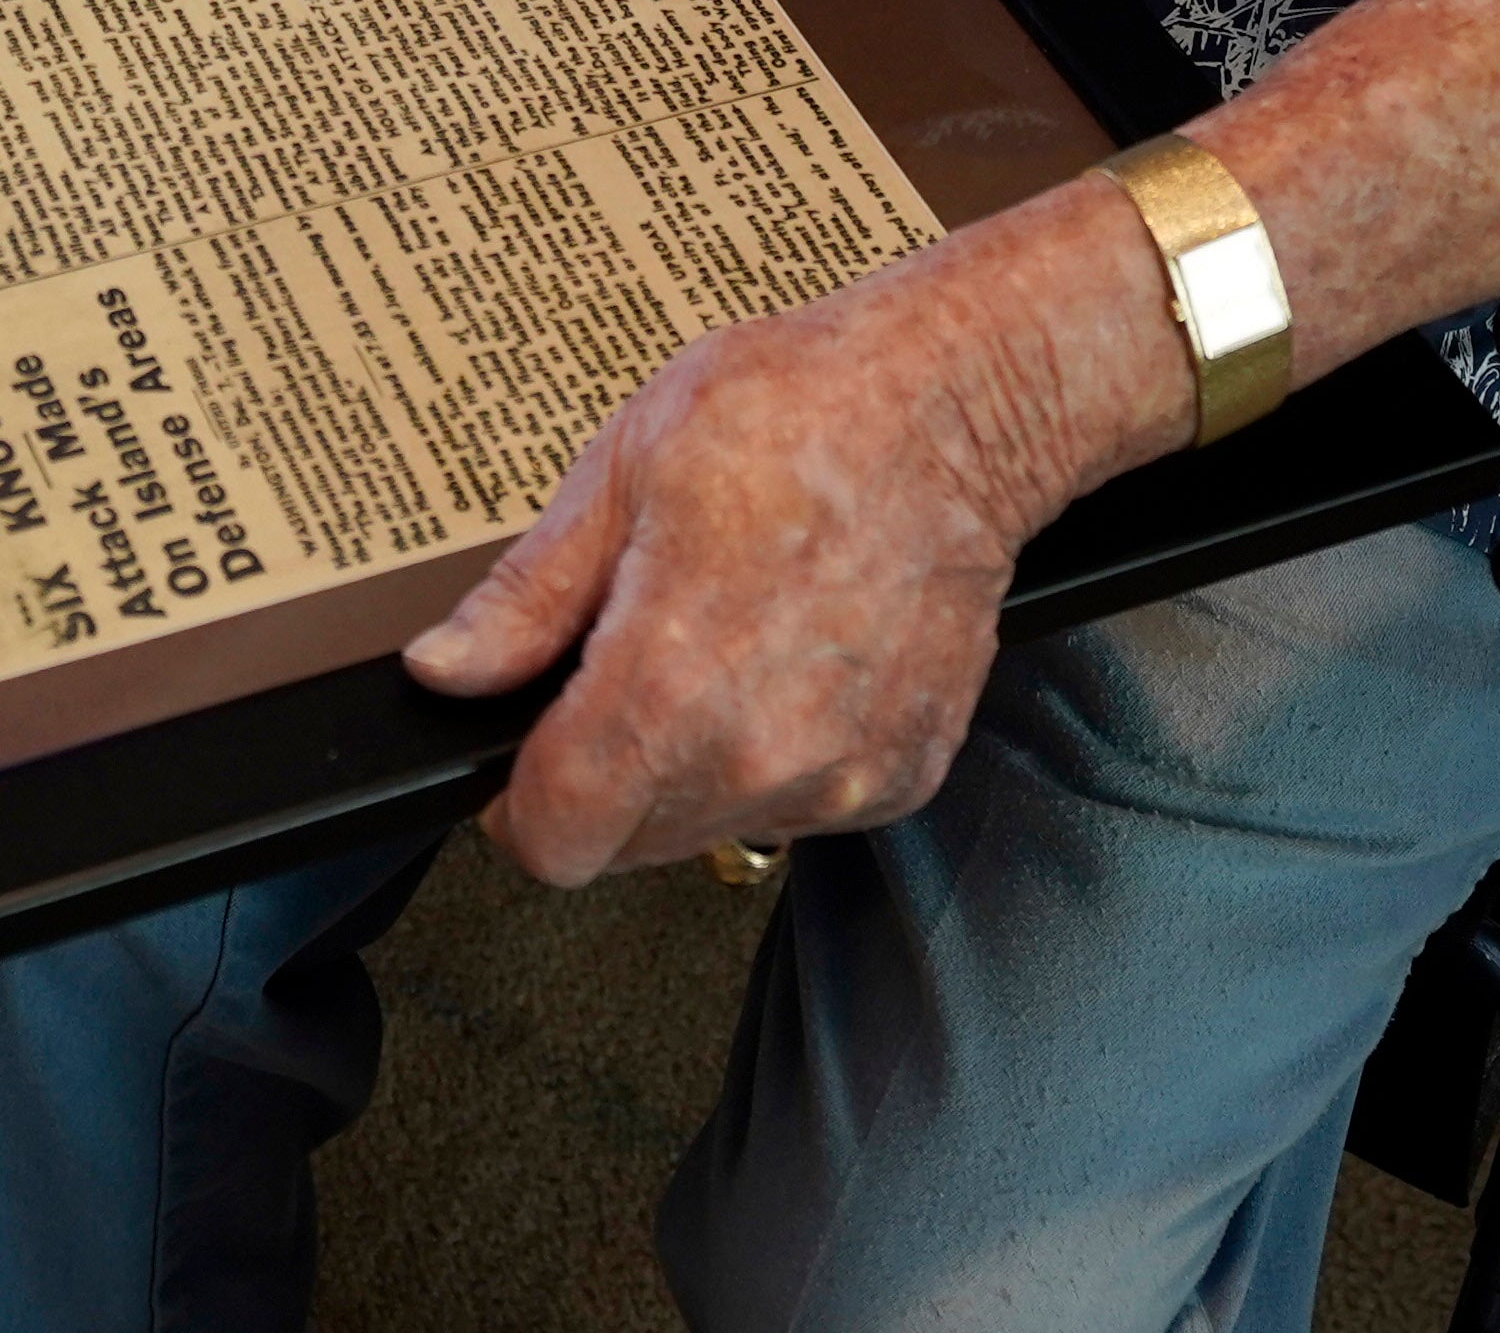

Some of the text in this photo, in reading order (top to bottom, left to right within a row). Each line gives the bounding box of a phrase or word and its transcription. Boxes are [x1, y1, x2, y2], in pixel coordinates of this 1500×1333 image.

[353, 77, 374, 95] OF
[368, 97, 402, 139] HOUR
[639, 220, 703, 306] IN UPROAR
[97, 287, 266, 583] Defense Areas
[12, 354, 166, 618] Attack Made
[76, 366, 209, 598] On Island's
[32, 563, 98, 647] SIX
